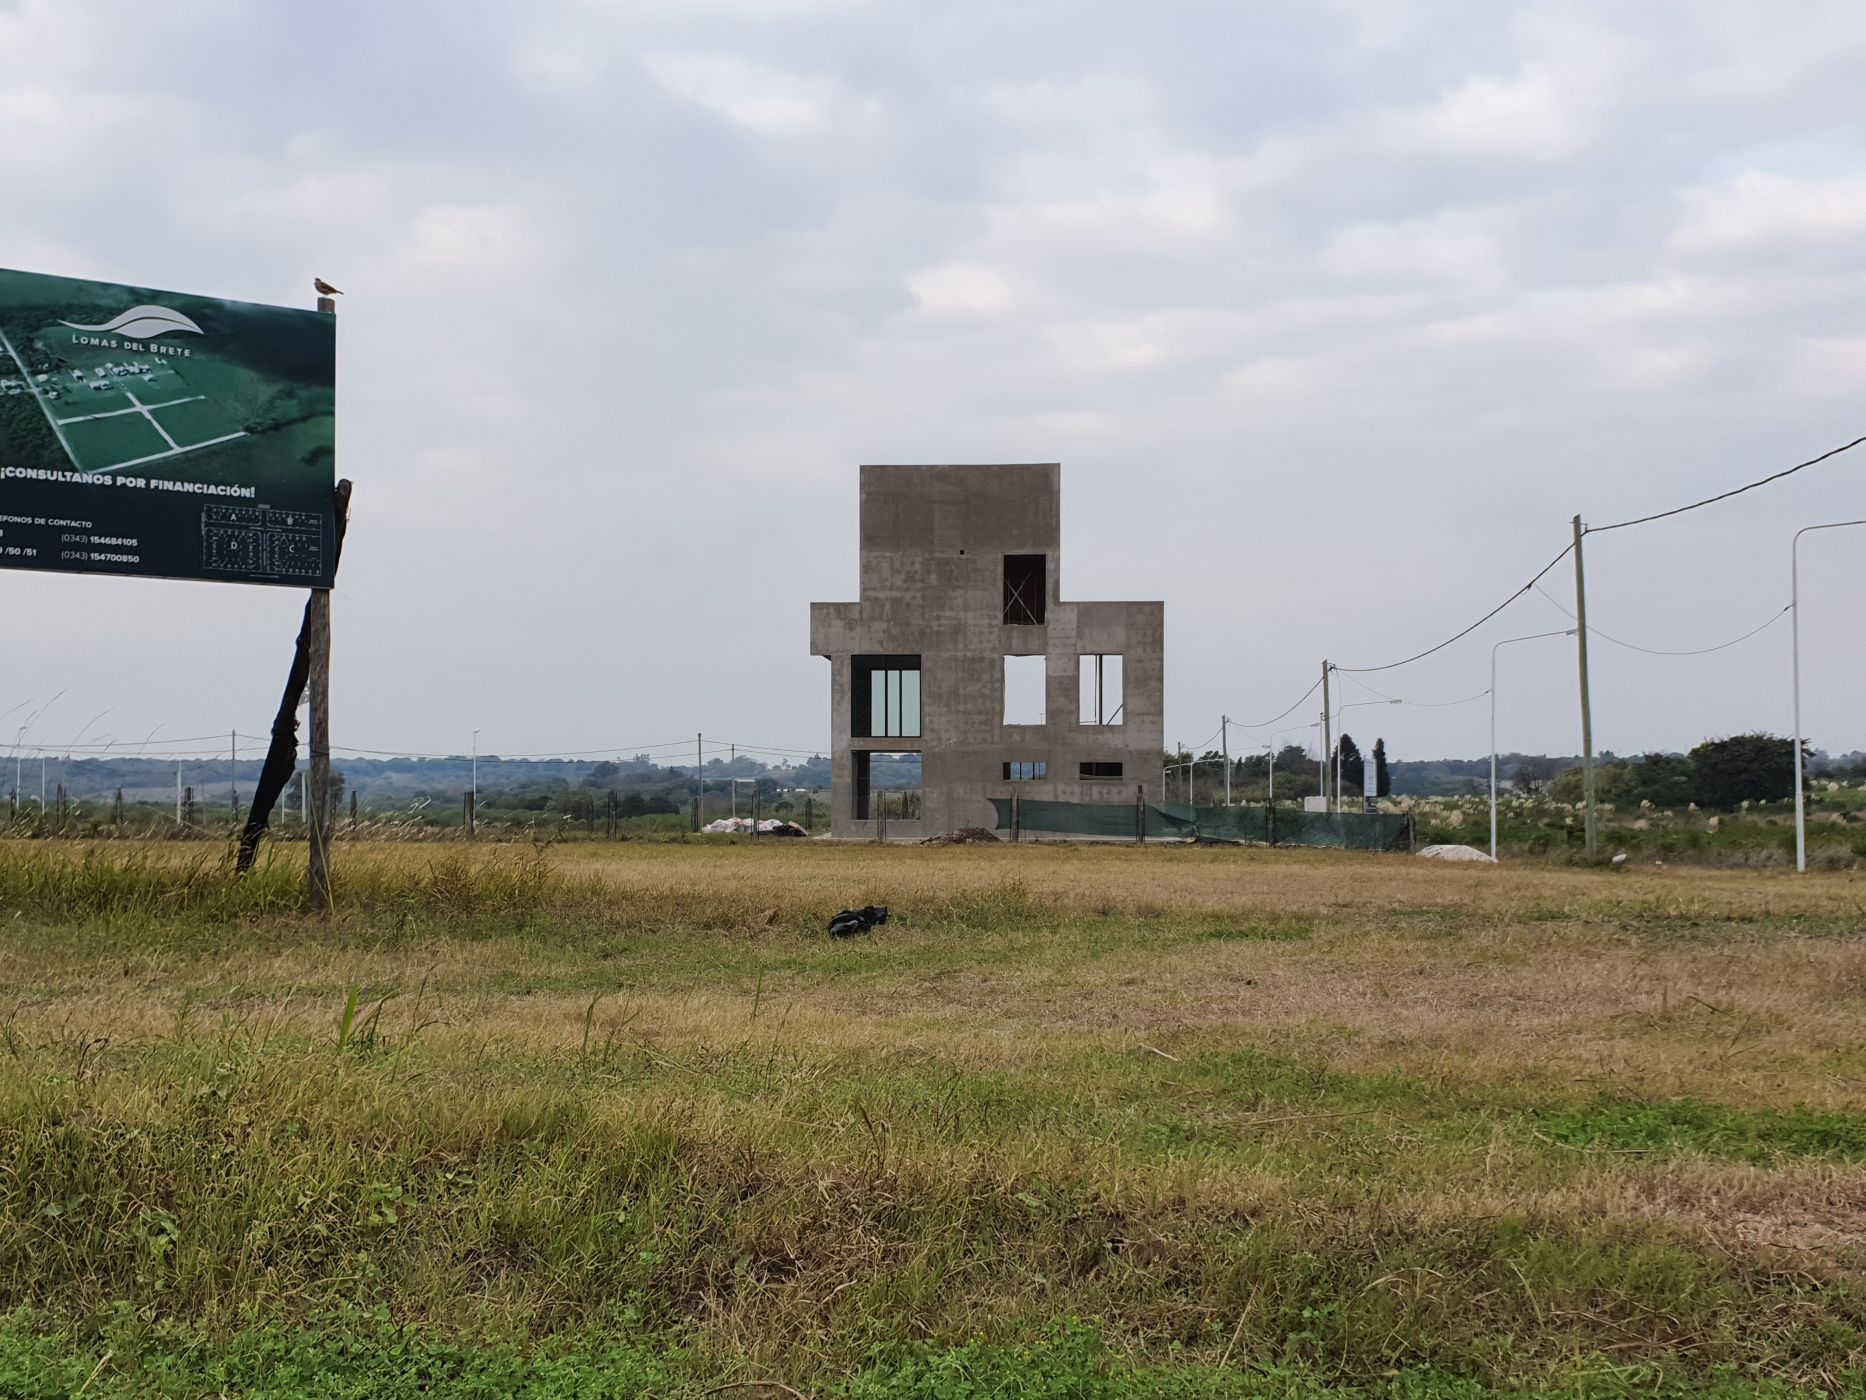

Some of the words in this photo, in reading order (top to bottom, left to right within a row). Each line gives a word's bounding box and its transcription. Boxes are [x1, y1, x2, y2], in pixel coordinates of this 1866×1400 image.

[72, 334, 117, 348] LOMAS
[124, 342, 145, 351] DEL
[150, 344, 191, 358] BRETE
[1, 466, 112, 485] ¡CONSULTANOS
[117, 476, 145, 488] POR
[150, 479, 255, 498] FINANCIACIÓN!
[230, 513, 236, 521] A
[48, 519, 93, 528] CONTACTO
[61, 534, 88, 544] (0343)
[231, 541, 237, 549] D
[289, 545, 295, 553] C
[5, 547, 21, 555] /50
[22, 548, 37, 557] /51
[61, 551, 88, 561] (0343)
